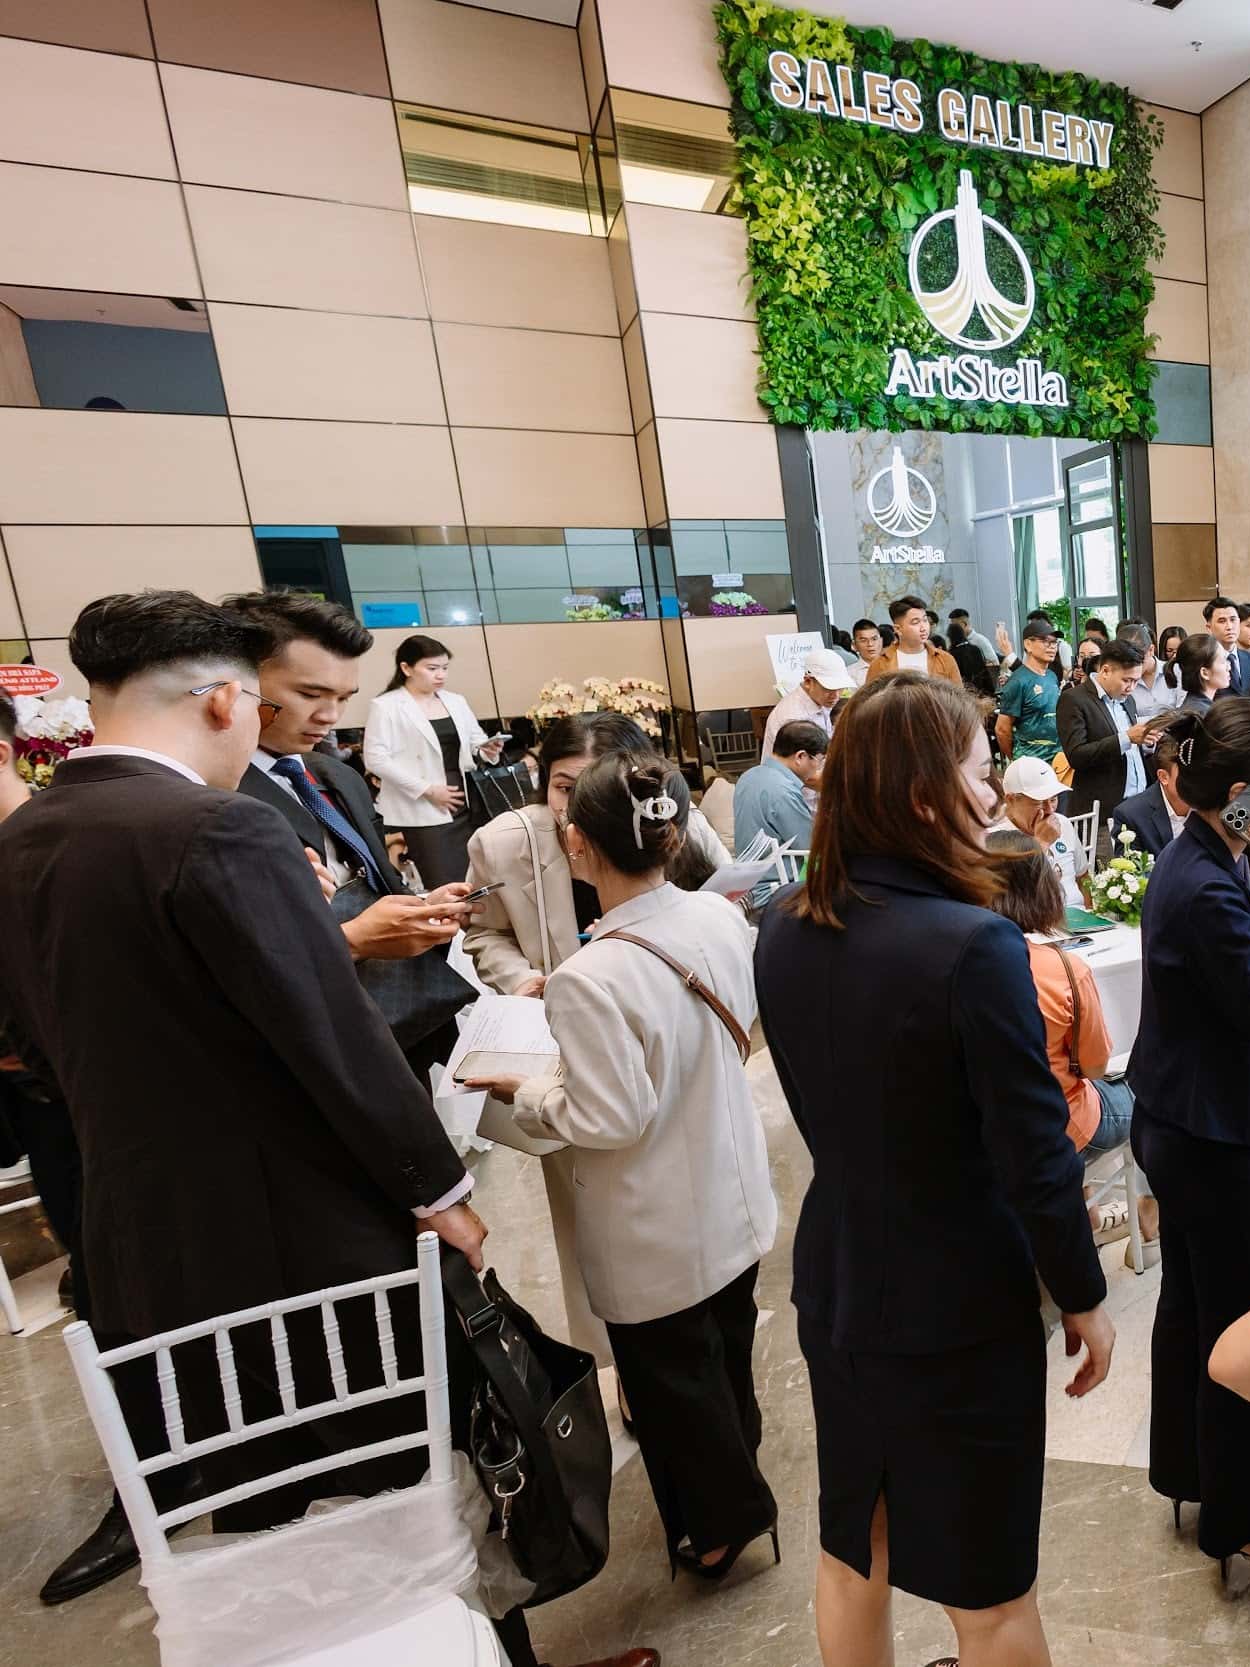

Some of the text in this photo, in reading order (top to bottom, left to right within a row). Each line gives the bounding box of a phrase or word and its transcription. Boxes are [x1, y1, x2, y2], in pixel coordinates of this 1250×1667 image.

[768, 51, 1114, 168] SALES GALLERY
[884, 348, 1069, 407] ArtStella
[870, 545, 945, 563] ArtStella
